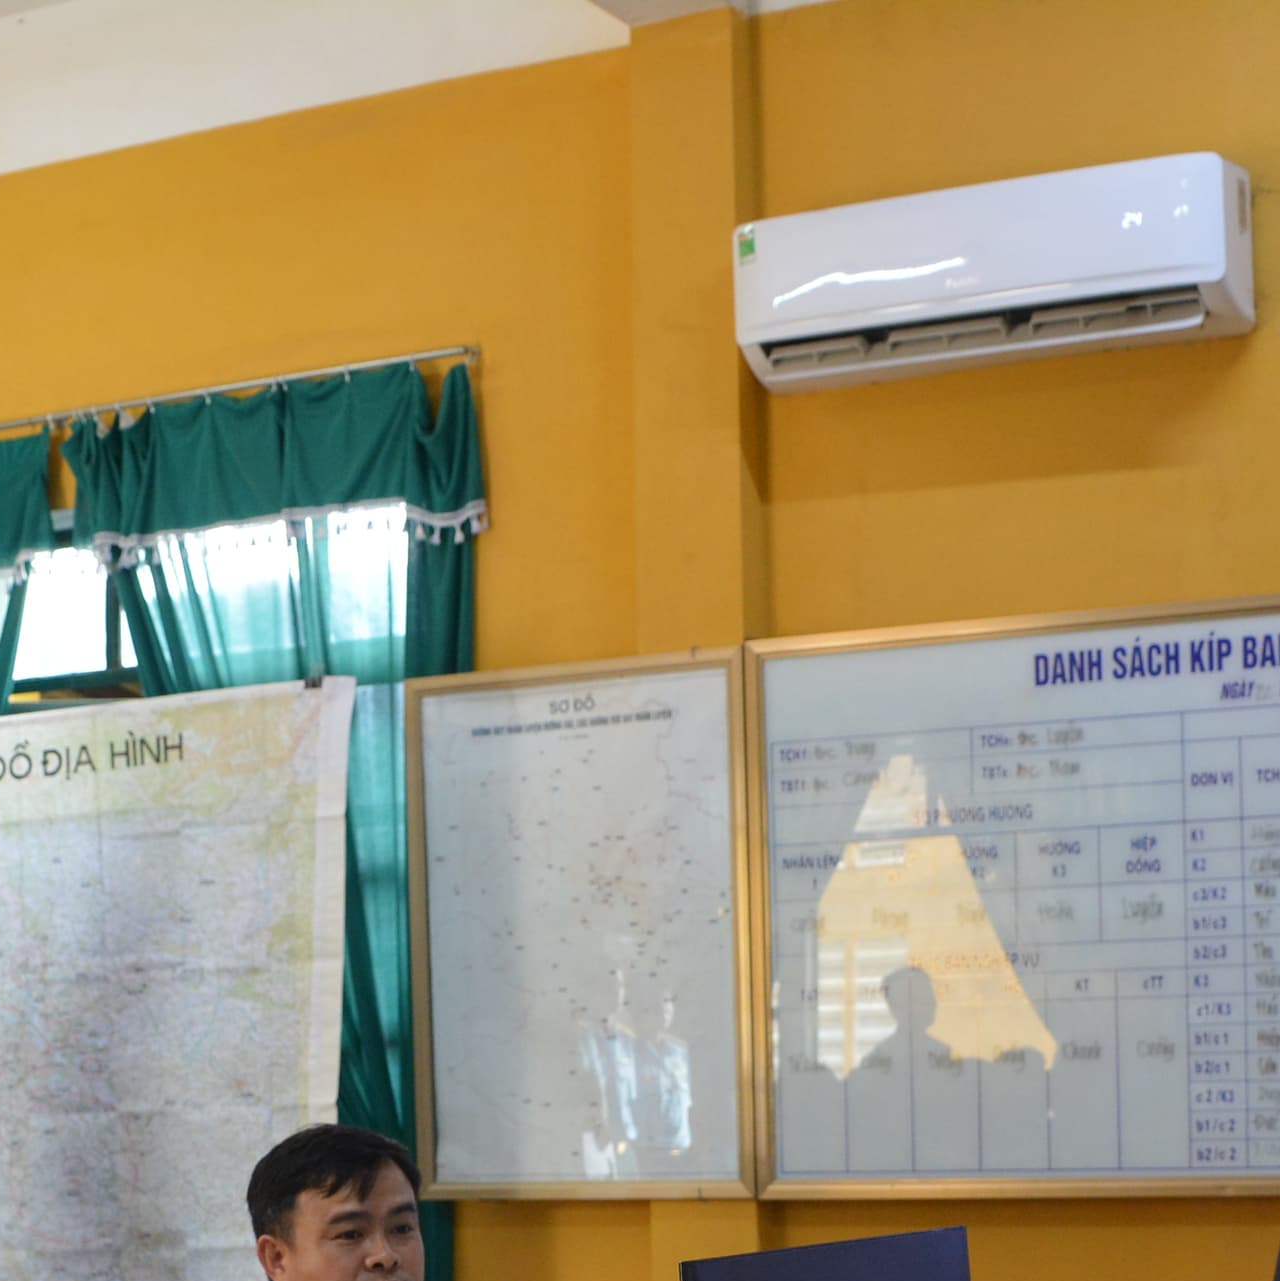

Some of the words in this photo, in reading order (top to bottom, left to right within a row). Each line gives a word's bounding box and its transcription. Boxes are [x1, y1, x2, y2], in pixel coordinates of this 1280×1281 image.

[1034, 647, 1103, 686] DANH
[1112, 637, 1181, 680] SÁCH
[1190, 631, 1232, 673] KÍP
[42, 745, 96, 780] ĐỊA
[110, 731, 184, 769] HÌNH
[1257, 768, 1280, 783] TCH
